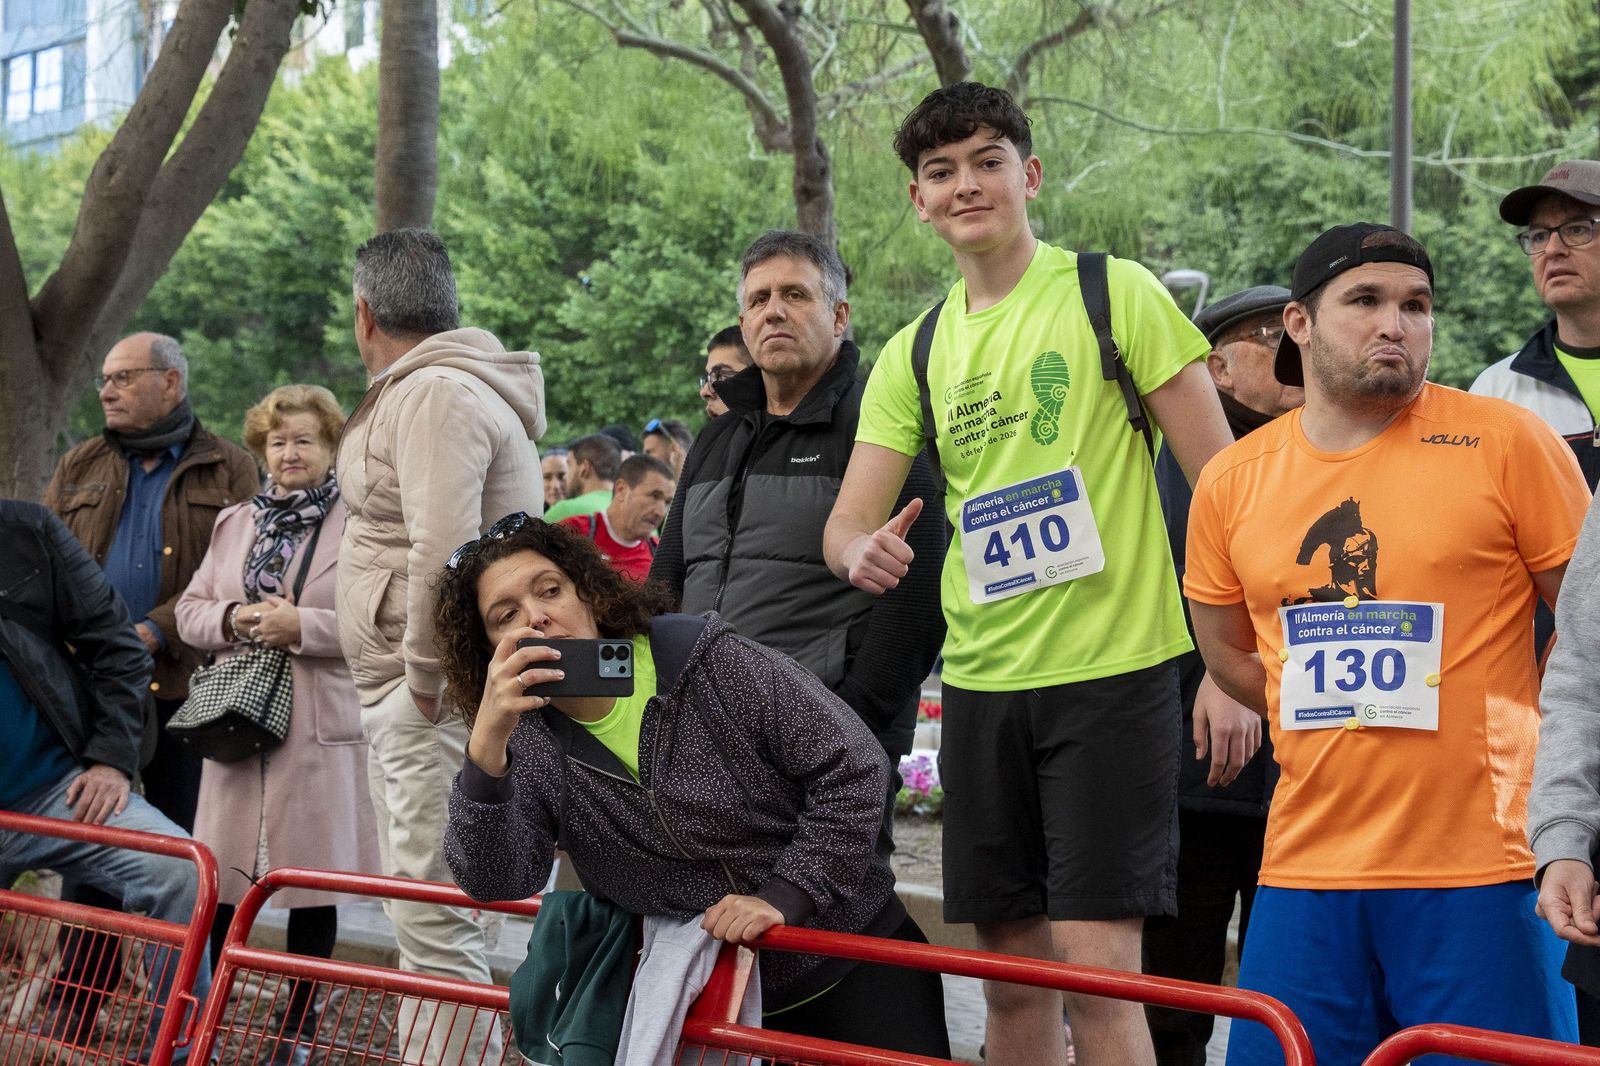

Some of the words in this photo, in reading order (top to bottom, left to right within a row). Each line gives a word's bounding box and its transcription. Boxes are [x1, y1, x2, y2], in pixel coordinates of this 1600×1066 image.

[949, 424, 963, 434] en
[954, 429, 986, 446] contra
[990, 410, 1029, 429] cáncer
[965, 449, 974, 457] de
[987, 437, 998, 445] de
[1005, 492, 1019, 502] en
[1021, 479, 1063, 498] marcha
[970, 510, 999, 526] contra
[1000, 505, 1012, 517] el
[1012, 495, 1049, 513] cáncer
[984, 514, 1070, 567] 410
[1347, 611, 1363, 621] en
[1366, 609, 1417, 621] marcha
[1298, 625, 1333, 638] contra
[1336, 624, 1348, 635] el
[1351, 623, 1397, 635] cáncer
[1304, 647, 1407, 694] 130
